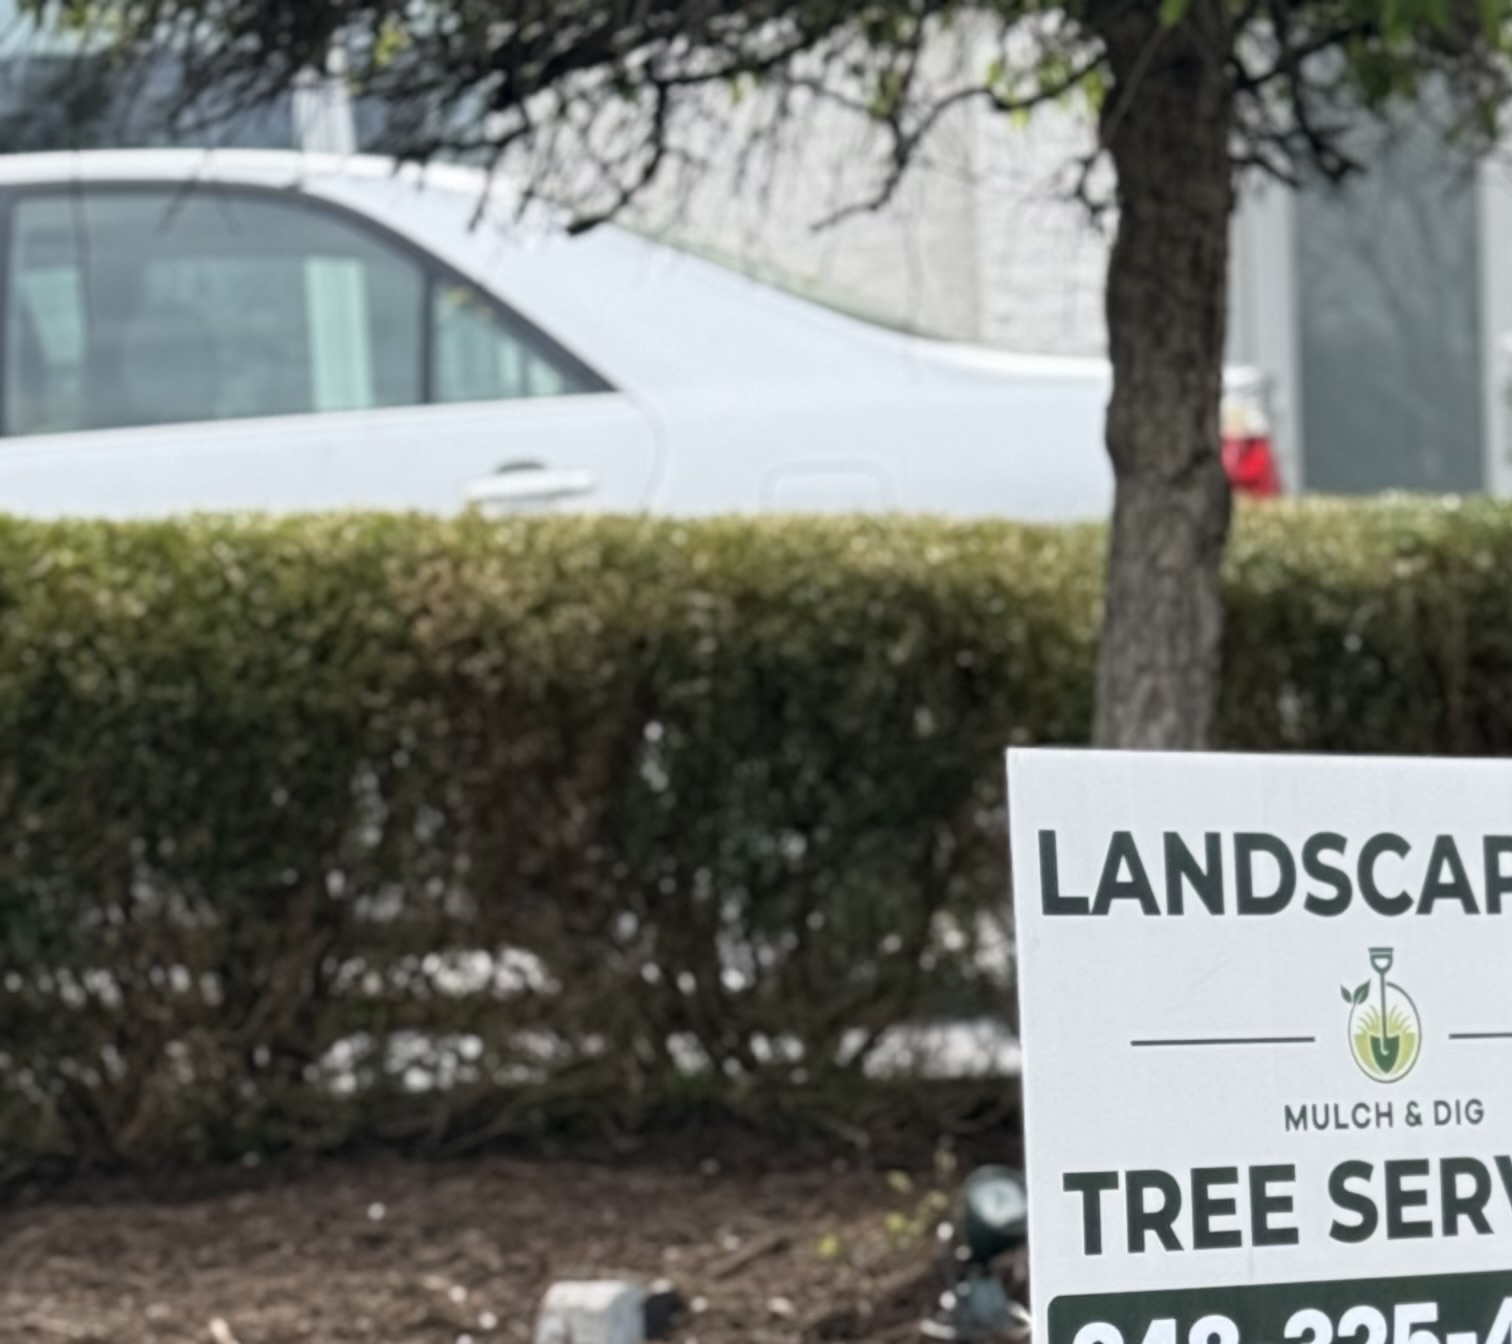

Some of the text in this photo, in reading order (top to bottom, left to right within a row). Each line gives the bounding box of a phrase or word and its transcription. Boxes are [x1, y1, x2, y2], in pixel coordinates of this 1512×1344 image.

[1284, 1099, 1485, 1131] MULCH & DIG
[1062, 1164, 1300, 1255] TREE
